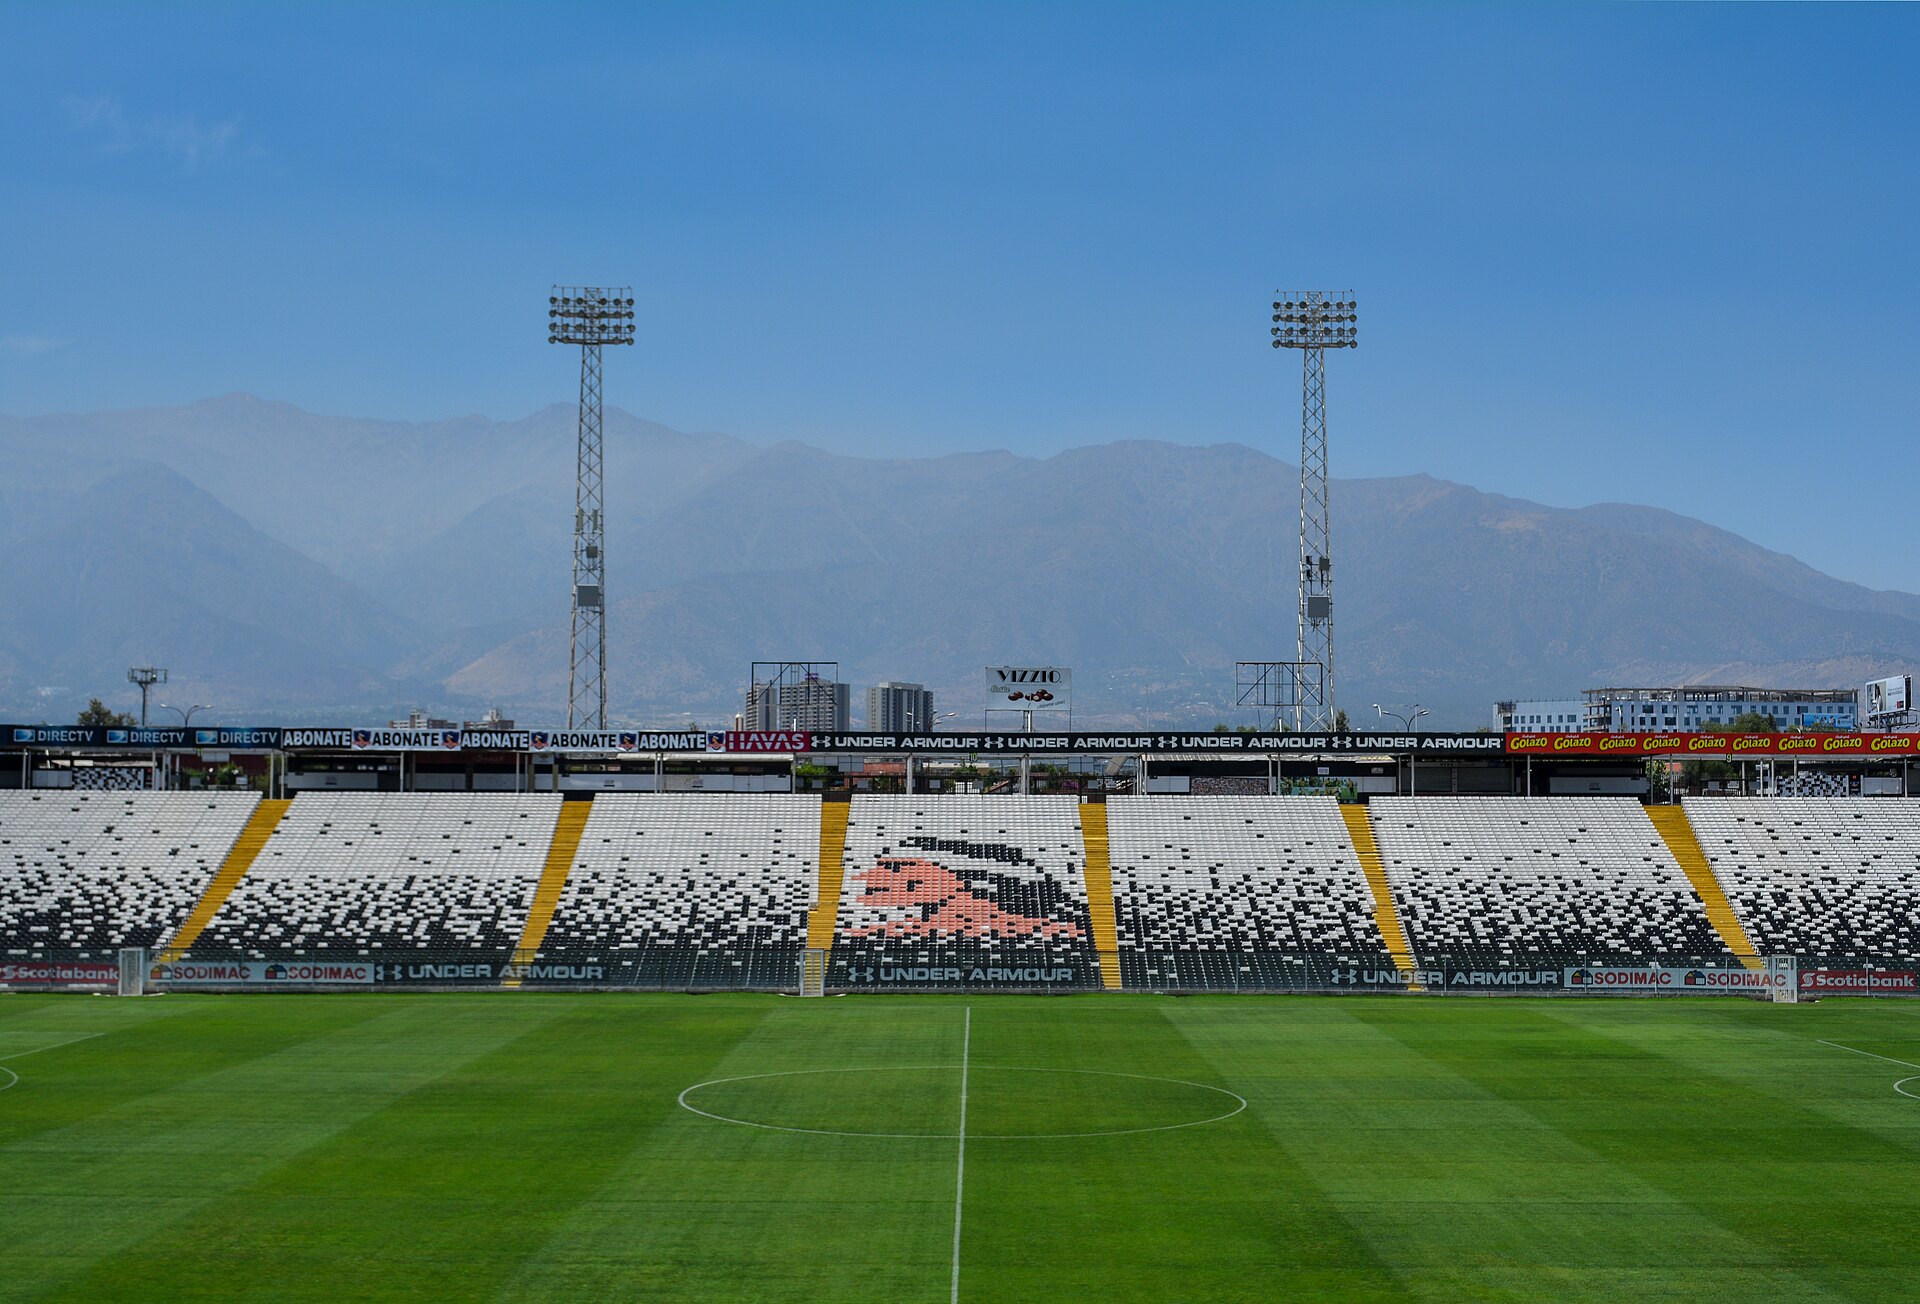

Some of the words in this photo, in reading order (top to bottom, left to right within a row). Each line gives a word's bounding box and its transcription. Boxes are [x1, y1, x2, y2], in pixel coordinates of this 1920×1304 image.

[996, 670, 1060, 683] VIZZIO
[38, 730, 93, 742] DIRECTV
[130, 731, 185, 743] DIRECTV
[220, 732, 277, 743] DIRECTV
[283, 729, 351, 747] ABONATE
[373, 731, 439, 747] ABONATE
[460, 732, 529, 748] ABONATE
[550, 733, 616, 748] ABONATE
[638, 733, 706, 749] ABONATE
[728, 733, 805, 750] HAVAS
[835, 736, 895, 747] UNDER
[901, 737, 979, 748] ARMOUR
[1008, 737, 1069, 748] UNDER
[1075, 737, 1155, 748] ARMOUR
[1182, 737, 1243, 748] UNDER
[1249, 737, 1329, 748] ARMOUR
[1356, 737, 1417, 748] UNDER
[1422, 737, 1503, 749] ARMOUR
[1510, 737, 1548, 750] Golazo
[1554, 737, 1591, 750] Golazo
[1599, 737, 1637, 750] Golazo
[1643, 737, 1681, 750] Golazo
[1688, 737, 1726, 750] Golazo
[1732, 737, 1771, 750] Golazo
[1778, 737, 1817, 751] Golazo
[1823, 737, 1862, 751] Golazo
[1870, 737, 1910, 751] Golazo
[1726, 753, 1732, 763] 9
[18, 965, 118, 980] Scotiabank
[174, 965, 250, 979] SODIMAC
[287, 966, 367, 980] SODIMAC
[408, 964, 492, 979] UNDER
[498, 964, 603, 980] ARMOUR
[879, 967, 960, 981] UNDER
[968, 967, 1073, 982] ARMOUR
[1362, 969, 1443, 984] UNDER
[1451, 969, 1558, 985] ARMOUR
[1593, 971, 1672, 985] SODIMAC
[1706, 972, 1787, 986] SODIMAC
[1816, 973, 1914, 987] Scotiabank
